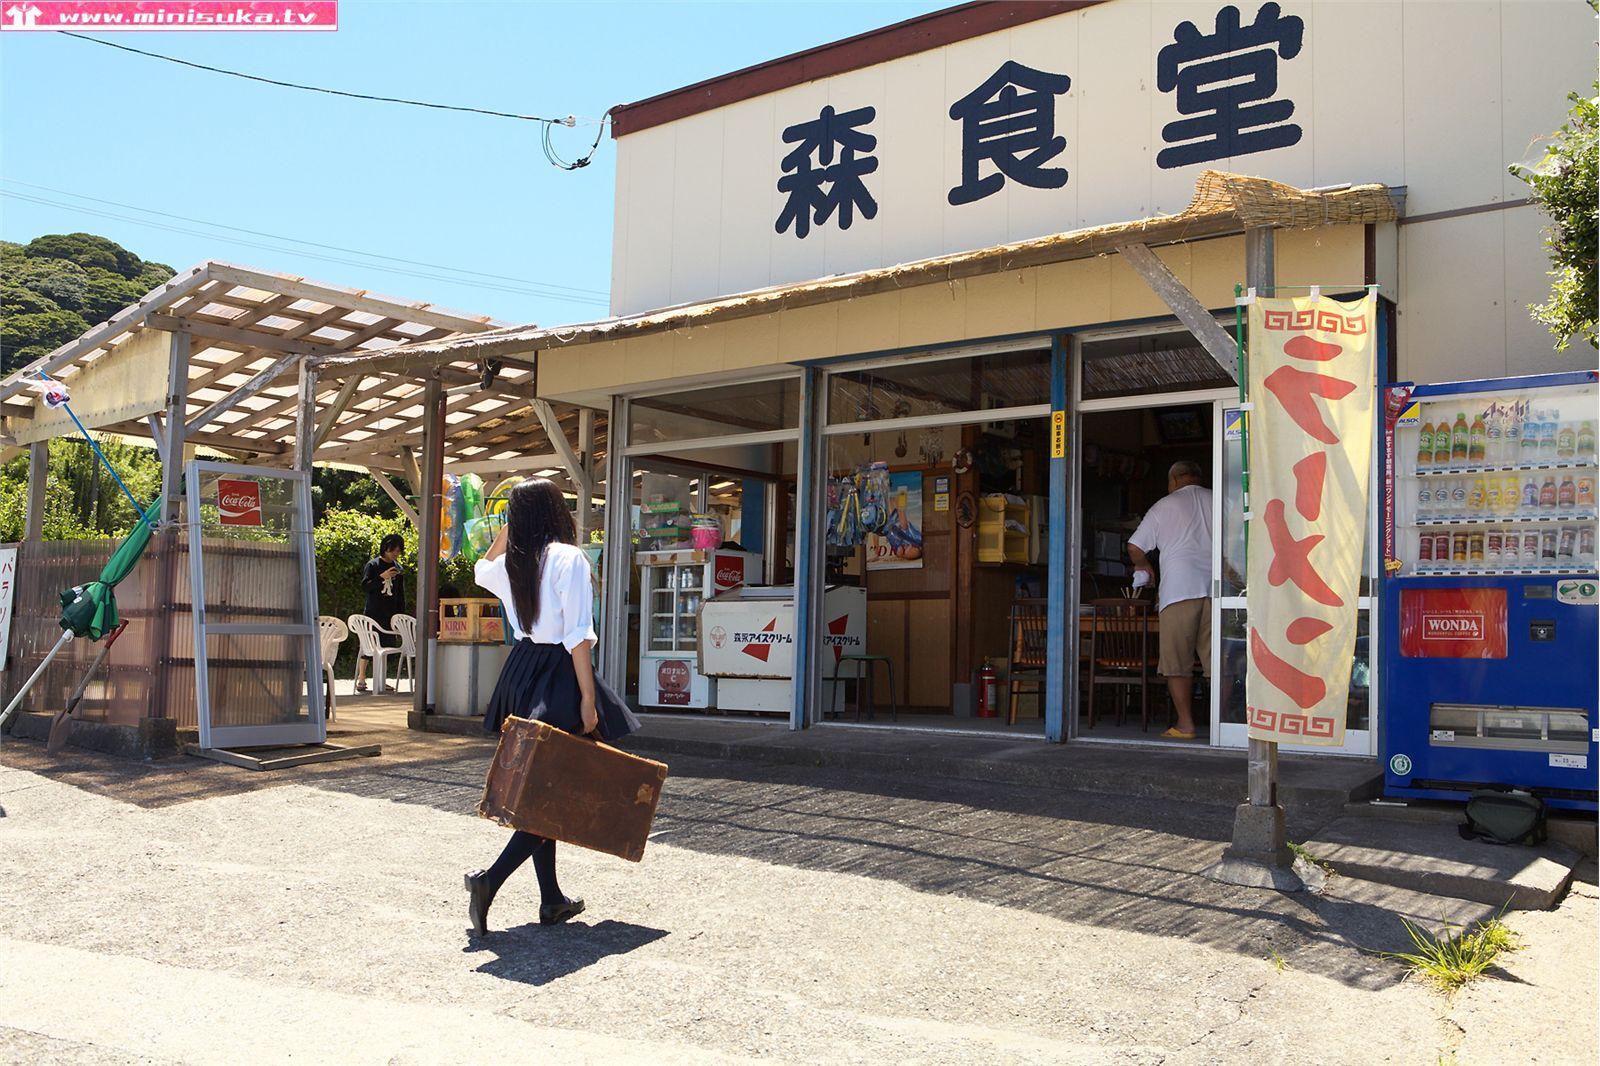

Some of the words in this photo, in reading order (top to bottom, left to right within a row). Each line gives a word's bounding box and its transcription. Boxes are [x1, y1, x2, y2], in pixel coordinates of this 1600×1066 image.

[775, 2, 1304, 239] 森食堂
[221, 494, 256, 508] Coca-Cola
[1251, 335, 1357, 709] ラーメン
[716, 569, 742, 582] Coca-Cola
[445, 620, 467, 631] KIRIN
[1428, 619, 1479, 631] WONDA
